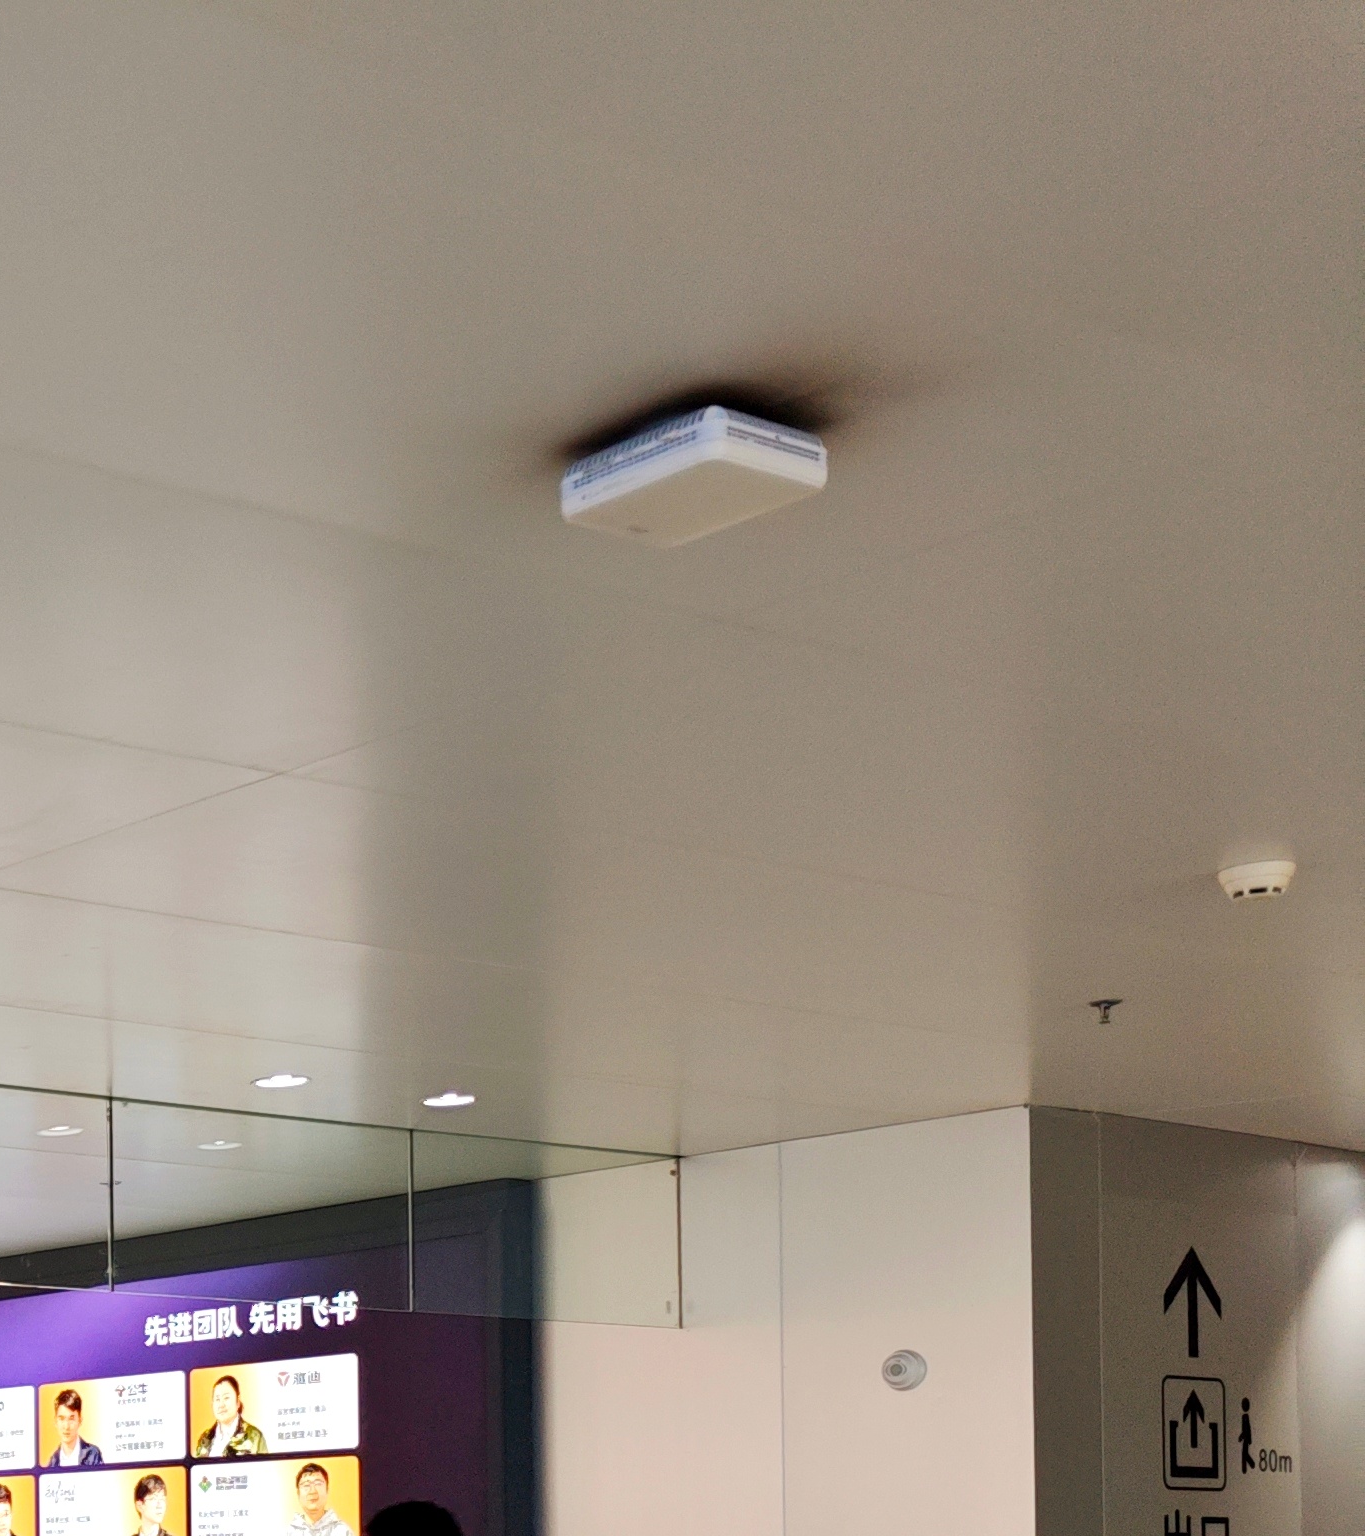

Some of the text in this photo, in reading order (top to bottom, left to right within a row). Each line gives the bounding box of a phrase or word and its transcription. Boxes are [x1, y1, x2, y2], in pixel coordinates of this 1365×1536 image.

[144, 1291, 359, 1347] 先进团队 先用飞书
[1258, 1448, 1293, 1473] 80m
